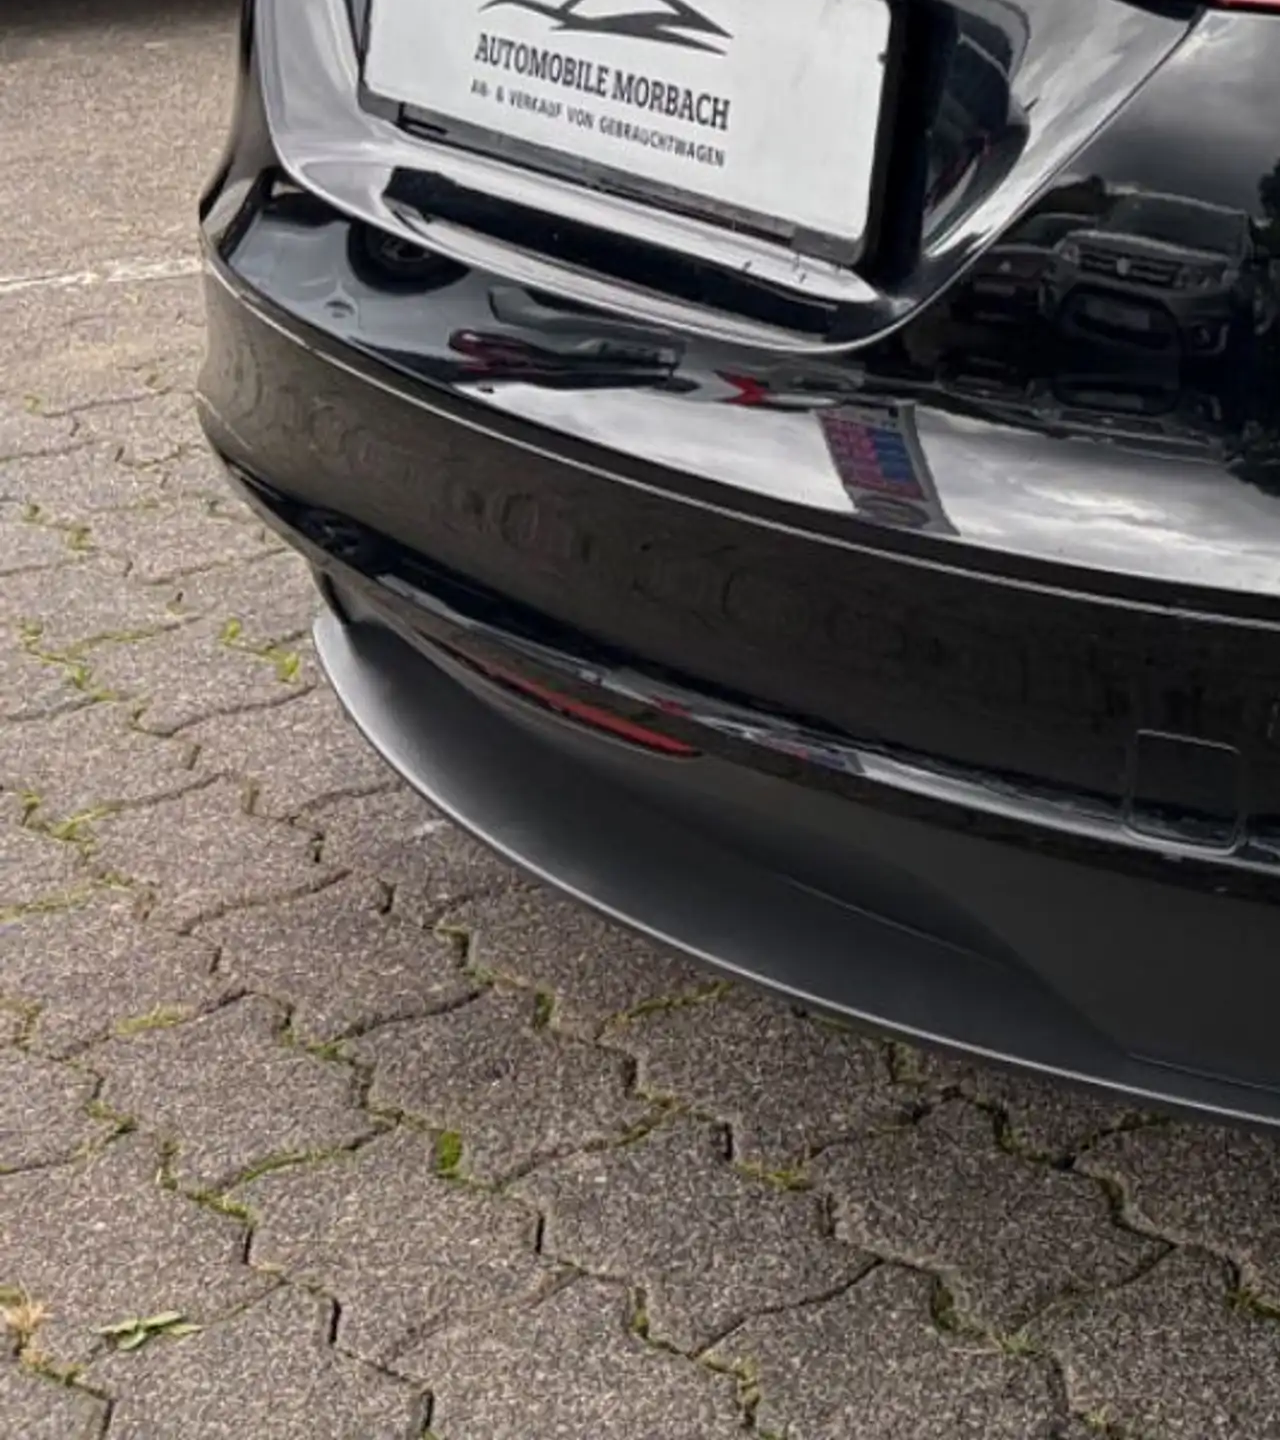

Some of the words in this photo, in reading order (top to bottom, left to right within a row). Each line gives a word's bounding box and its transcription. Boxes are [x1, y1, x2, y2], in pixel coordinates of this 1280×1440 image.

[474, 33, 609, 98] AUTOMOBILE
[611, 70, 731, 131] MORBACH
[509, 90, 562, 118] VERKAUF
[566, 109, 594, 130] VON
[599, 115, 725, 167] GEBRAUCHTWAGEN
